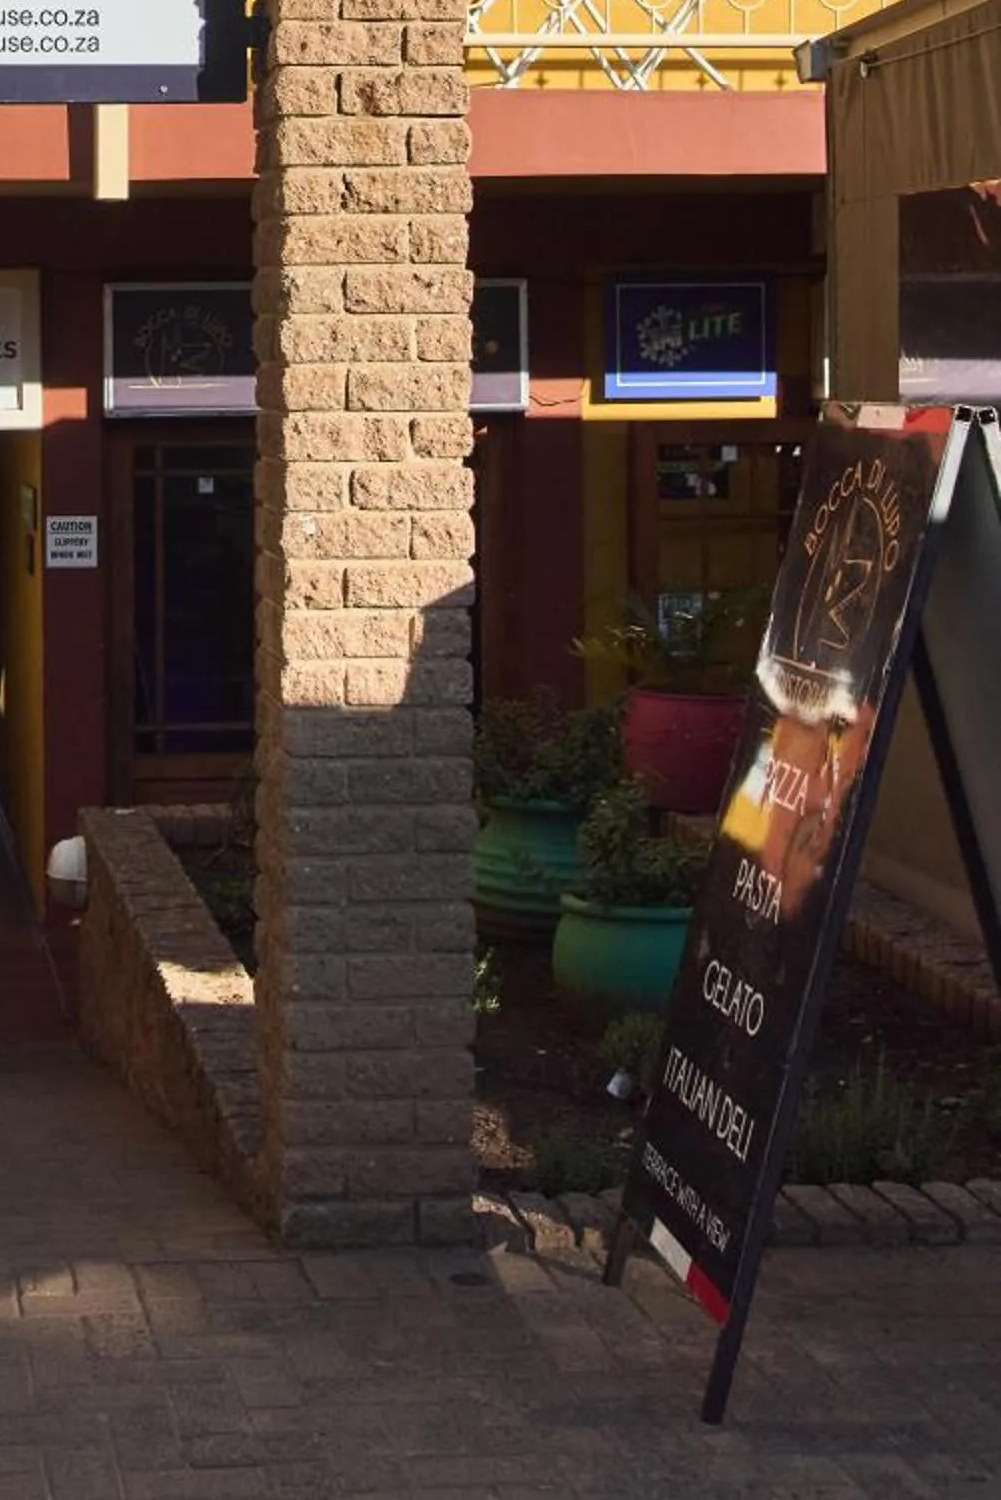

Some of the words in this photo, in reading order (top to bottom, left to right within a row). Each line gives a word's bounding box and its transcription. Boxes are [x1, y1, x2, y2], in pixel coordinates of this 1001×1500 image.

[688, 311, 743, 341] LITE
[51, 520, 92, 532] CAUTION
[804, 459, 863, 557] BOCCA
[761, 756, 810, 817] PIZZA
[732, 858, 783, 925] PASTA
[702, 959, 765, 1037] GELATO
[663, 1046, 723, 1131] ITALIAN
[716, 1097, 756, 1163] DELI
